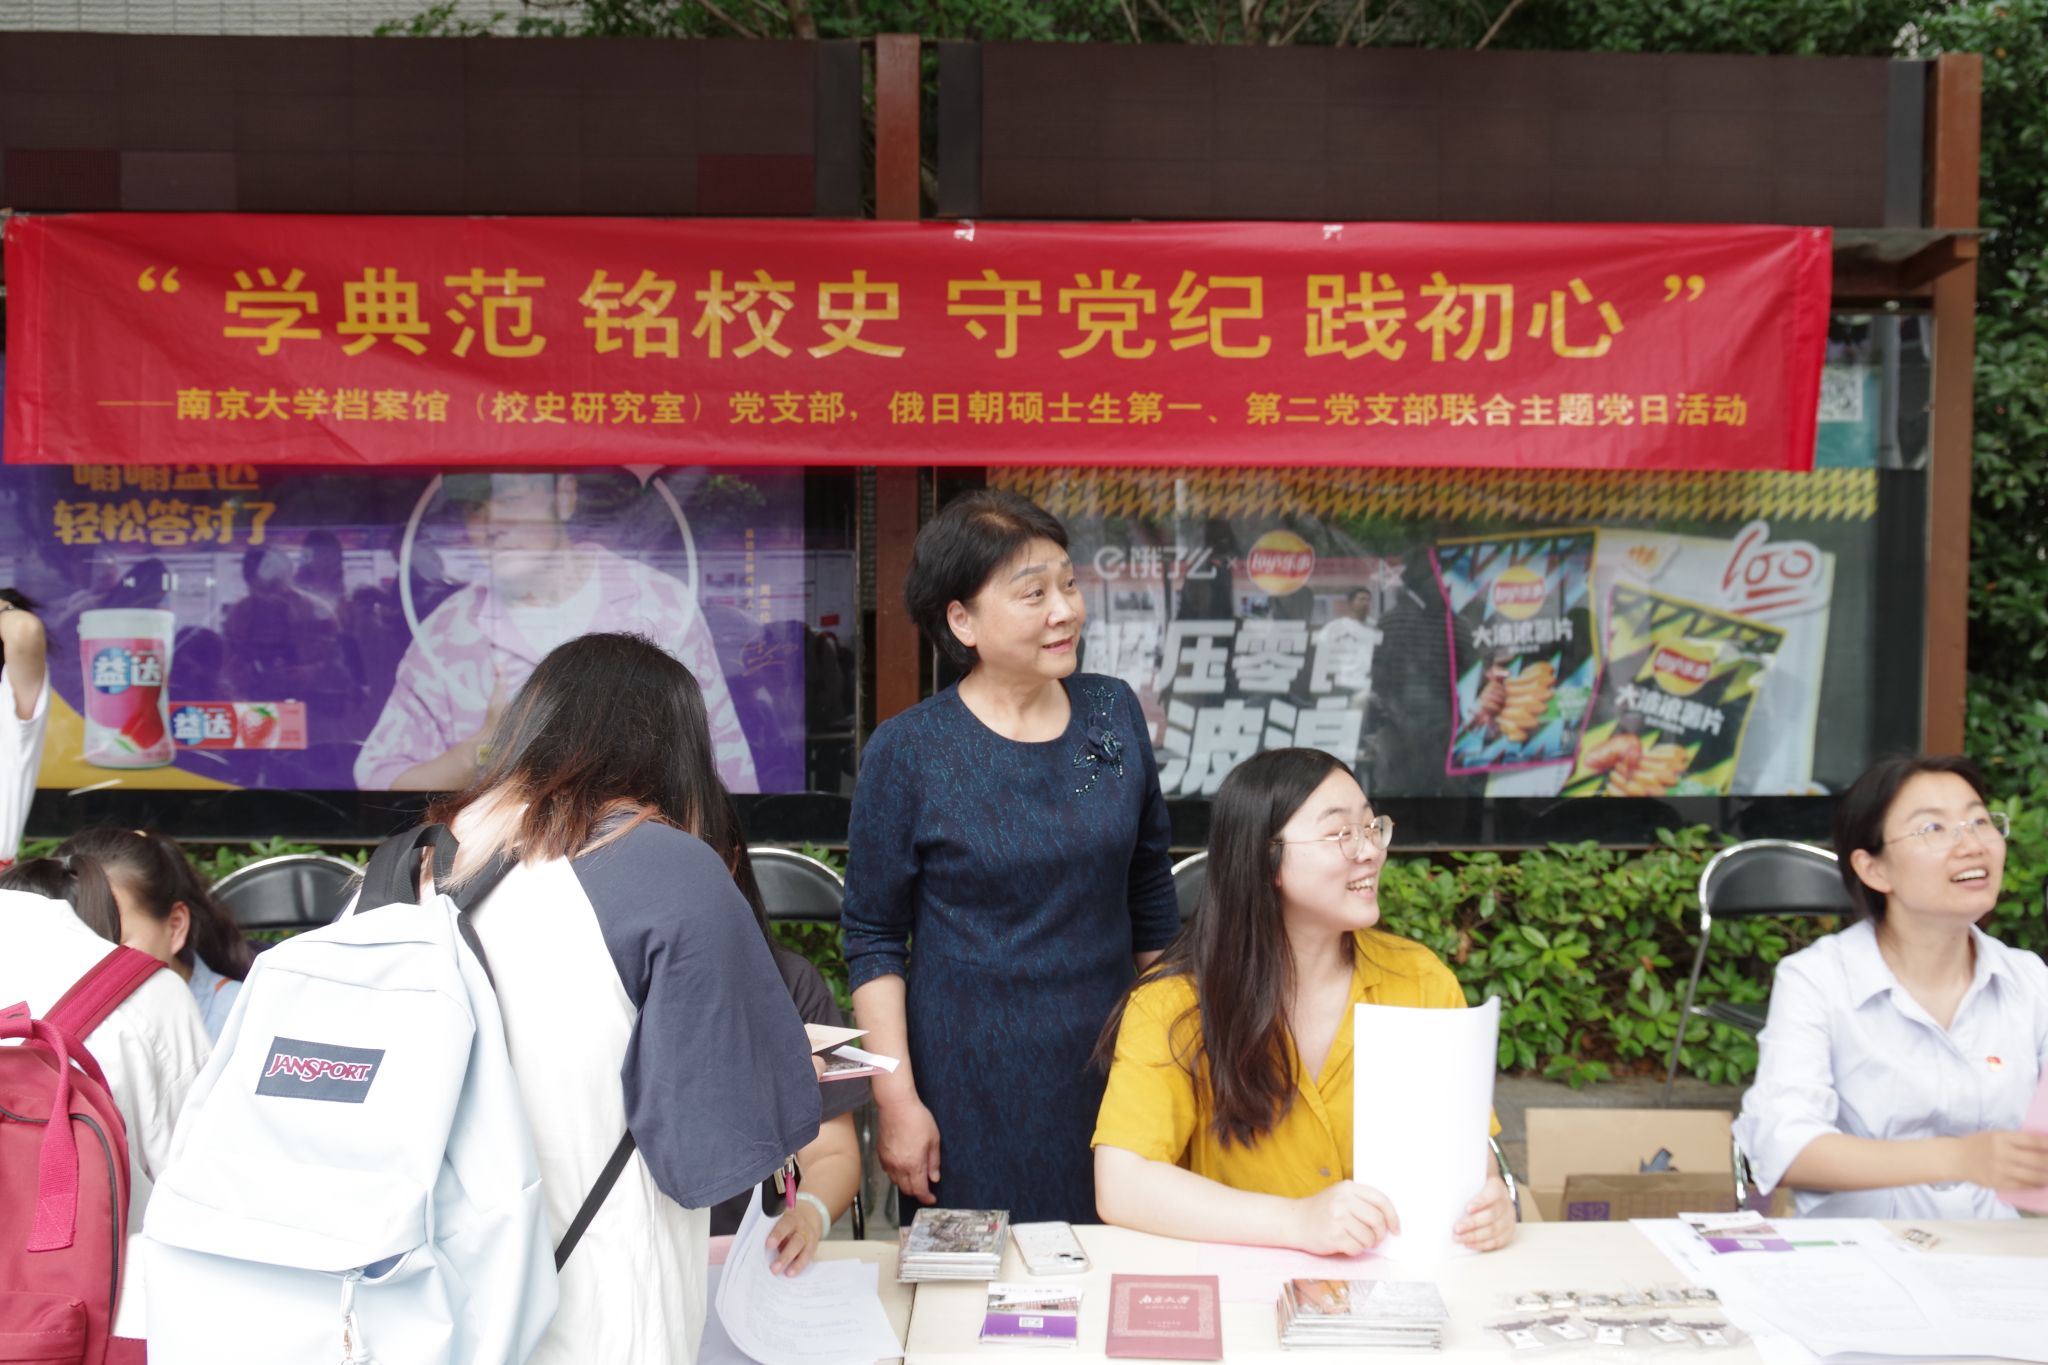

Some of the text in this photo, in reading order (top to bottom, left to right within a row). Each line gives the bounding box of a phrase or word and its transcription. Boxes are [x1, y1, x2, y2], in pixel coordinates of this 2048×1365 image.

[578, 269, 906, 359] 铭校史
[947, 269, 1272, 360] 守党纪
[53, 498, 277, 546] 轻松答对了
[93, 654, 162, 687] 益达
[173, 711, 233, 740] 益达
[264, 1053, 373, 1083] JANSPORT
